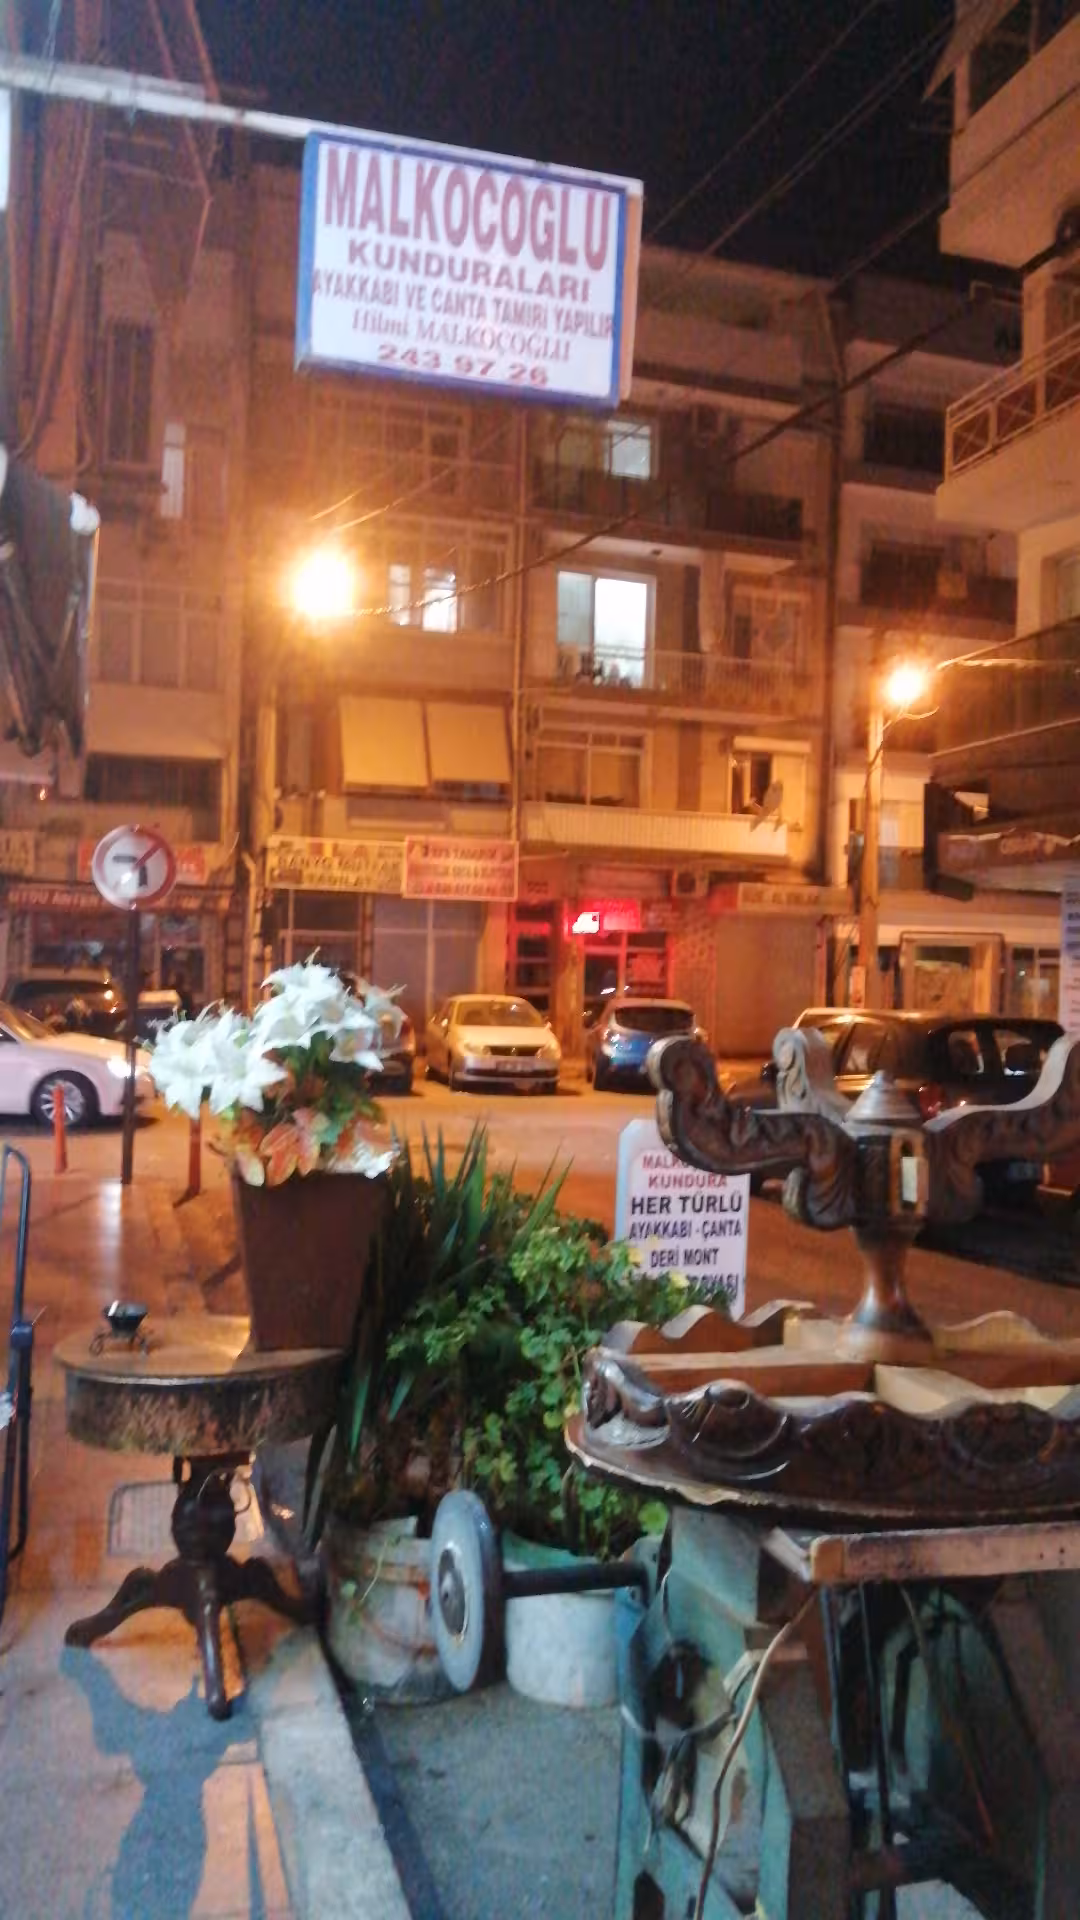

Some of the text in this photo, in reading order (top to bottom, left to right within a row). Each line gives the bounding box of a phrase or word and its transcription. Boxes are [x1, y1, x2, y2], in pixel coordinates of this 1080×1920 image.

[349, 239, 590, 303] KUNDURALARI
[313, 268, 399, 308] AYAKKABI
[405, 283, 427, 312] VE
[351, 307, 410, 338] Hilmi
[377, 343, 550, 387] 243 97 26
[647, 1173, 728, 1190] KUNDURA
[631, 1188, 742, 1216] HER TÜRLÜ
[629, 1220, 693, 1240] AYAKKABI
[702, 1218, 742, 1240] ÇANTA
[682, 1246, 720, 1267] MONT
